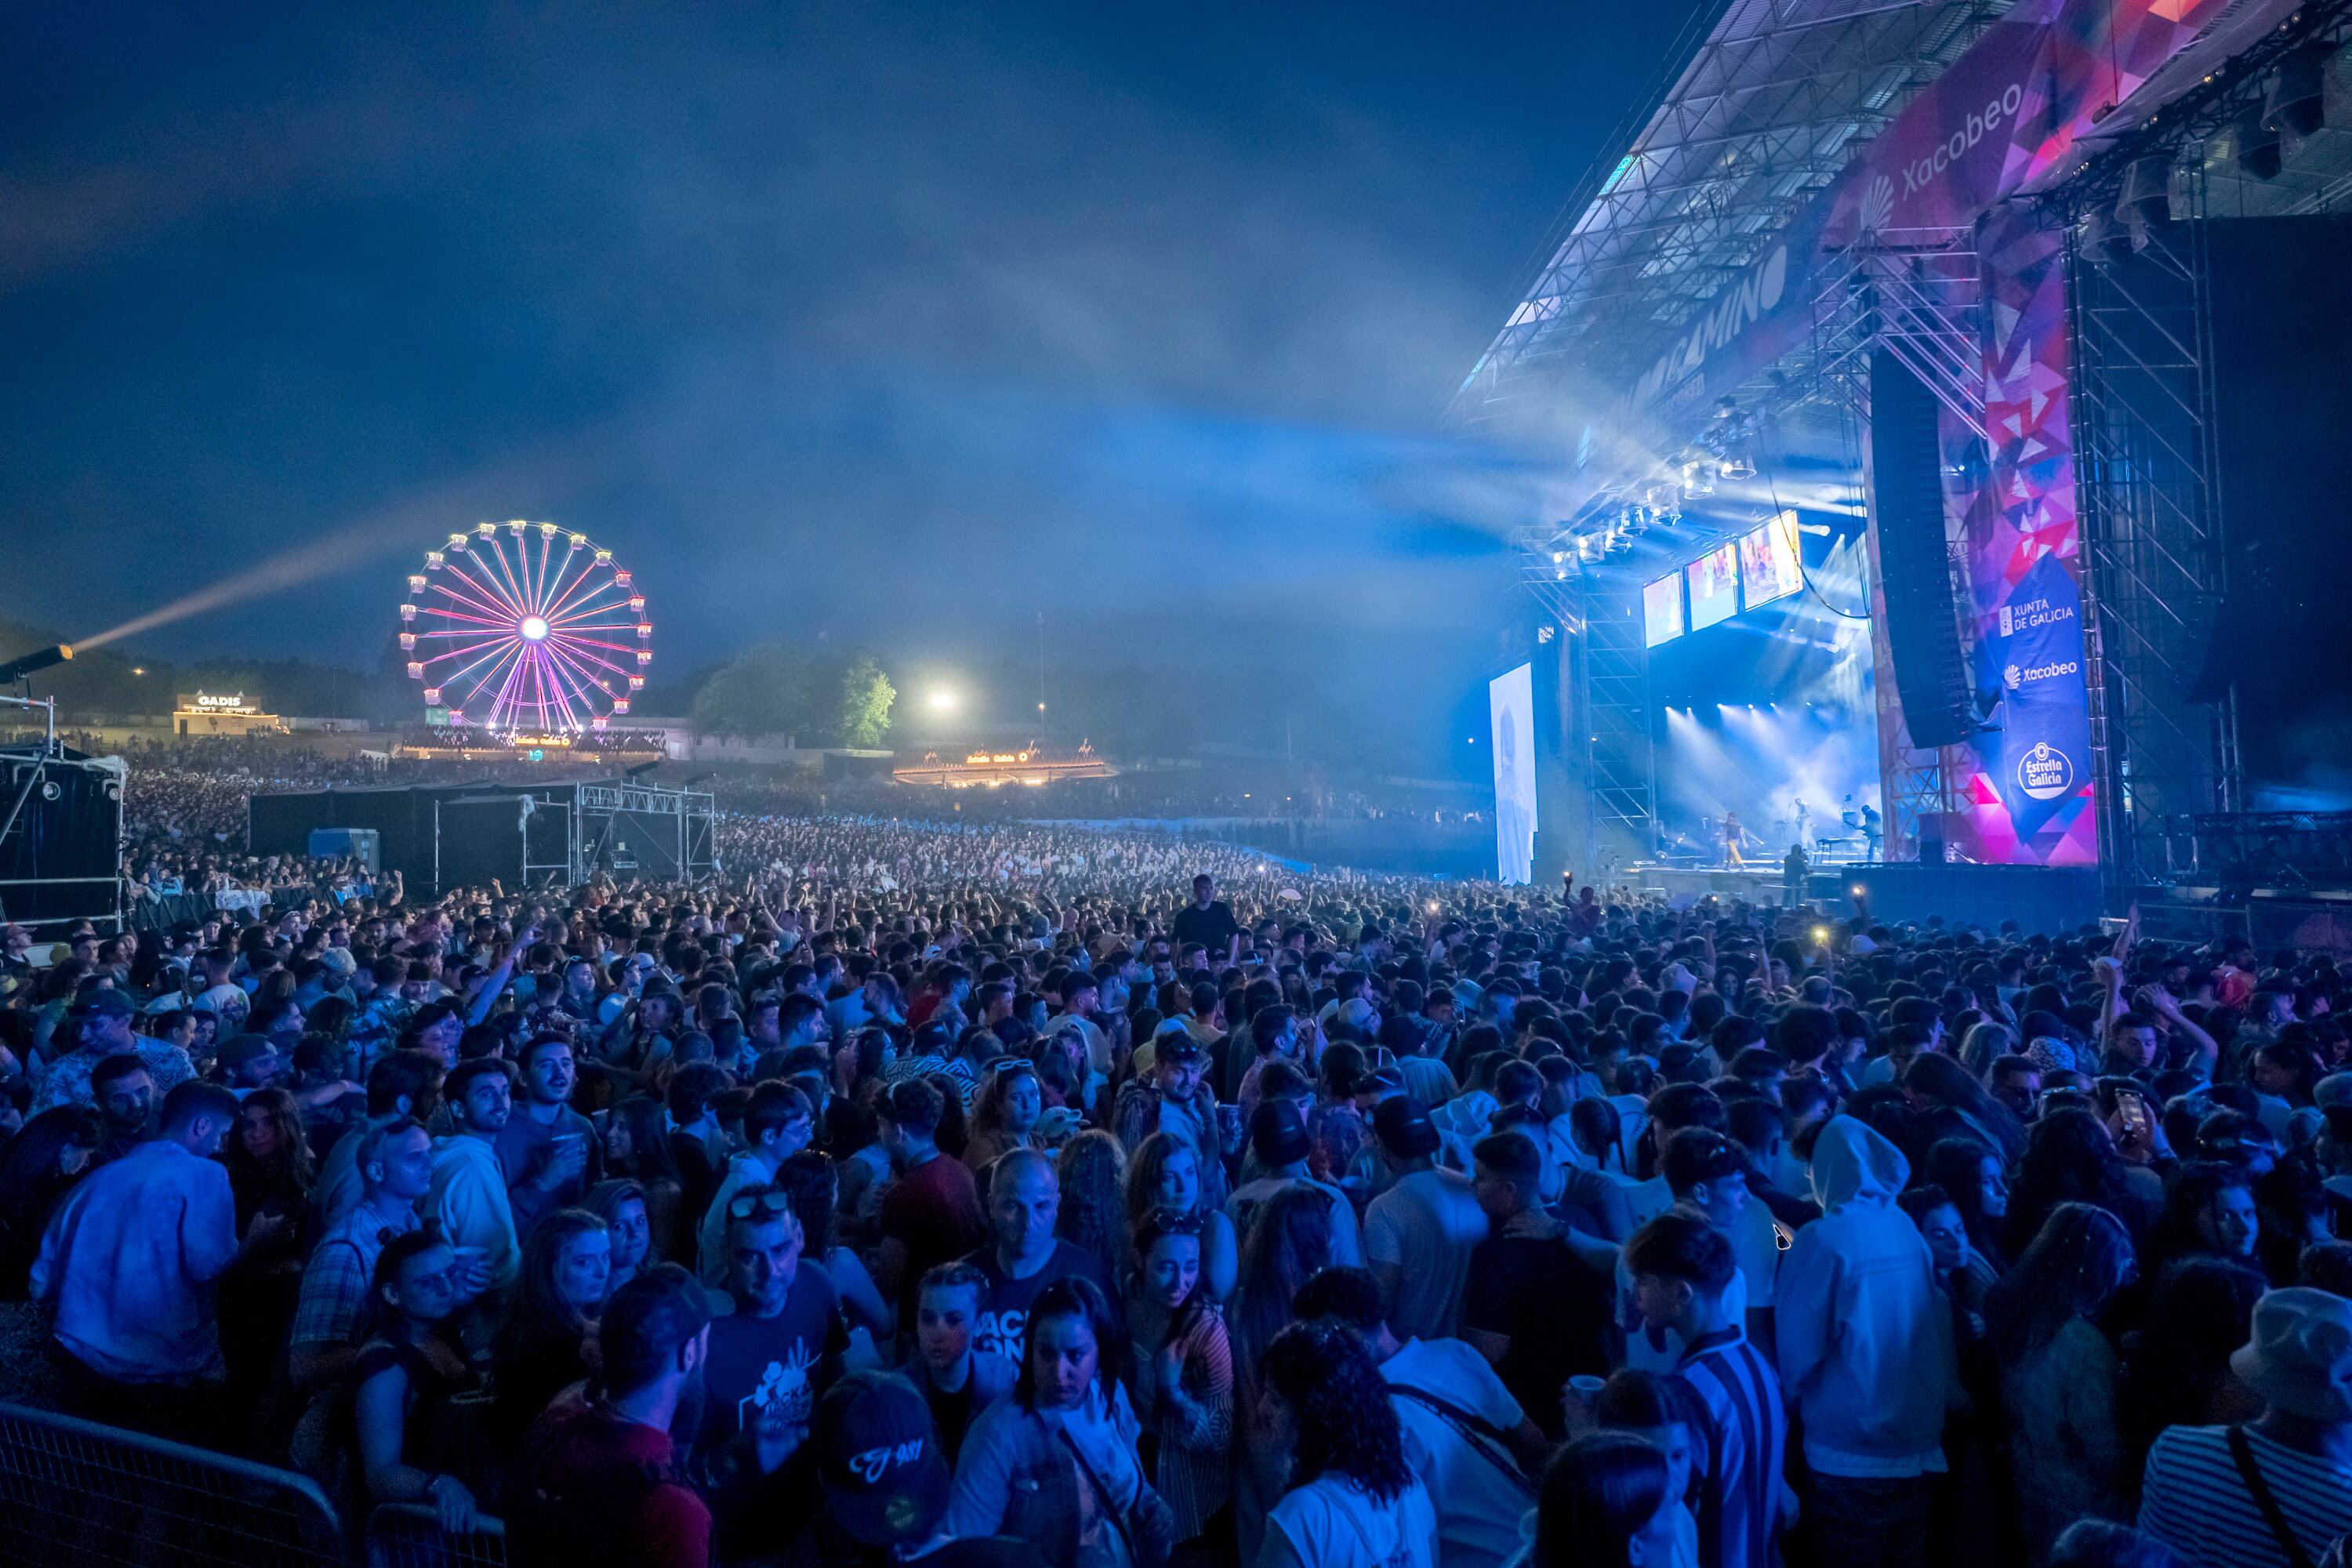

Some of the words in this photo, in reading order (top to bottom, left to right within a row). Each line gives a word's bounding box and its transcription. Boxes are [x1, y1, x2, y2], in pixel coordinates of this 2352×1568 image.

[1902, 83, 2022, 201] Xacobeo
[2014, 598, 2049, 617] XUNTA
[2014, 617, 2027, 631] DE
[2029, 606, 2074, 626] GALICIA
[2023, 662, 2078, 681] Xacobeo
[198, 695, 241, 706] GADIS
[2026, 759, 2063, 773] Estrella
[2028, 771, 2062, 786] Galicia
